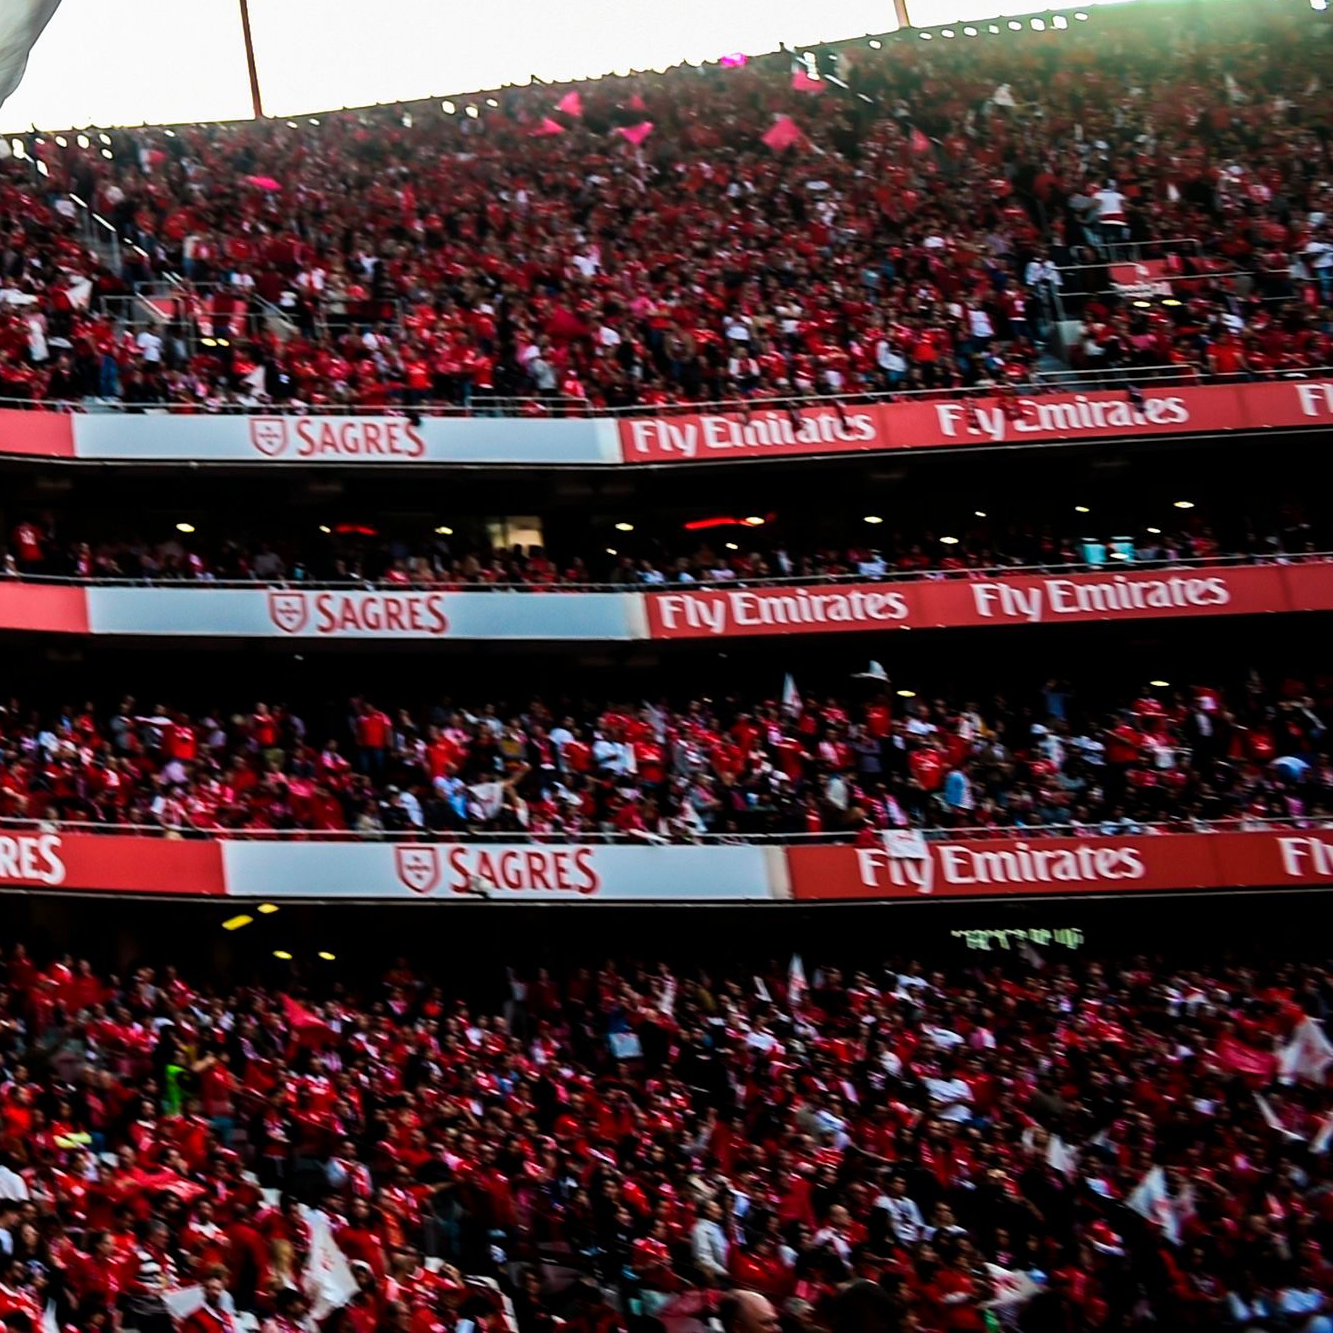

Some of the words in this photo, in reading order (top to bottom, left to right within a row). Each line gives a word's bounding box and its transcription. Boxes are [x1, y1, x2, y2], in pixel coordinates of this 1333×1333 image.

[296, 419, 426, 458] SAGRES
[630, 419, 698, 457] Fly
[935, 402, 1005, 441] Fy
[315, 594, 449, 635] SAGRES
[656, 595, 726, 634] Fly
[727, 588, 909, 625] Emirates
[970, 582, 1043, 622] Fly
[1044, 575, 1231, 613] Emirates
[447, 846, 600, 896] SAGRES
[936, 842, 1145, 884] Emirates
